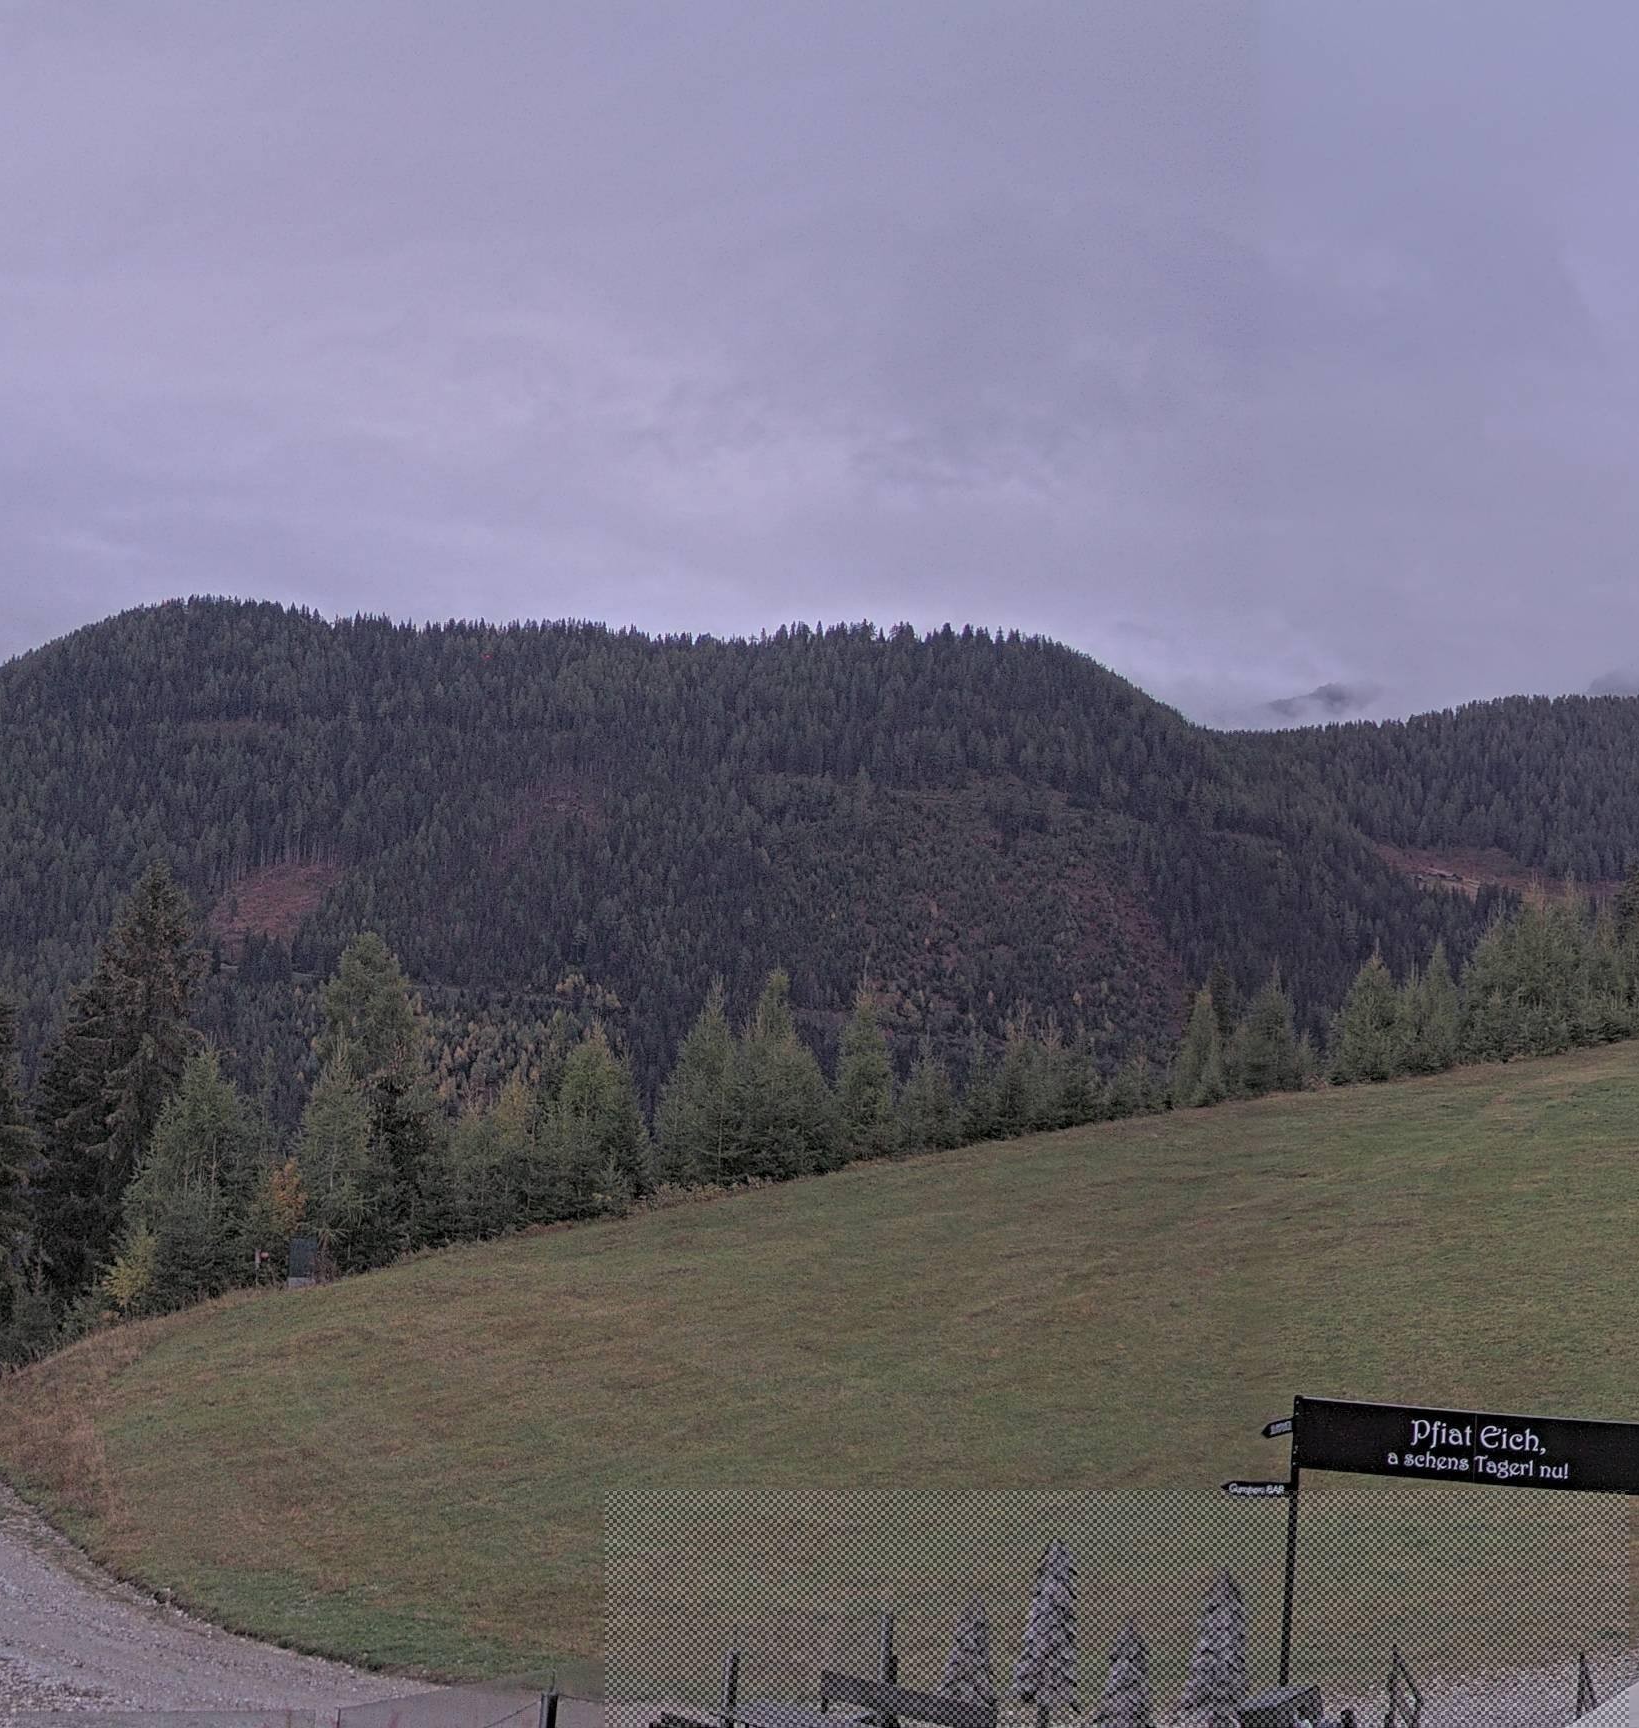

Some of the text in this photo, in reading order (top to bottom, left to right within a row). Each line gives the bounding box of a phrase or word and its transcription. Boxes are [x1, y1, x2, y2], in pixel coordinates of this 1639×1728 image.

[1410, 1419, 1547, 1456] Pfiat Eich,
[1387, 1451, 1569, 1479] a schens Tagerl nu!
